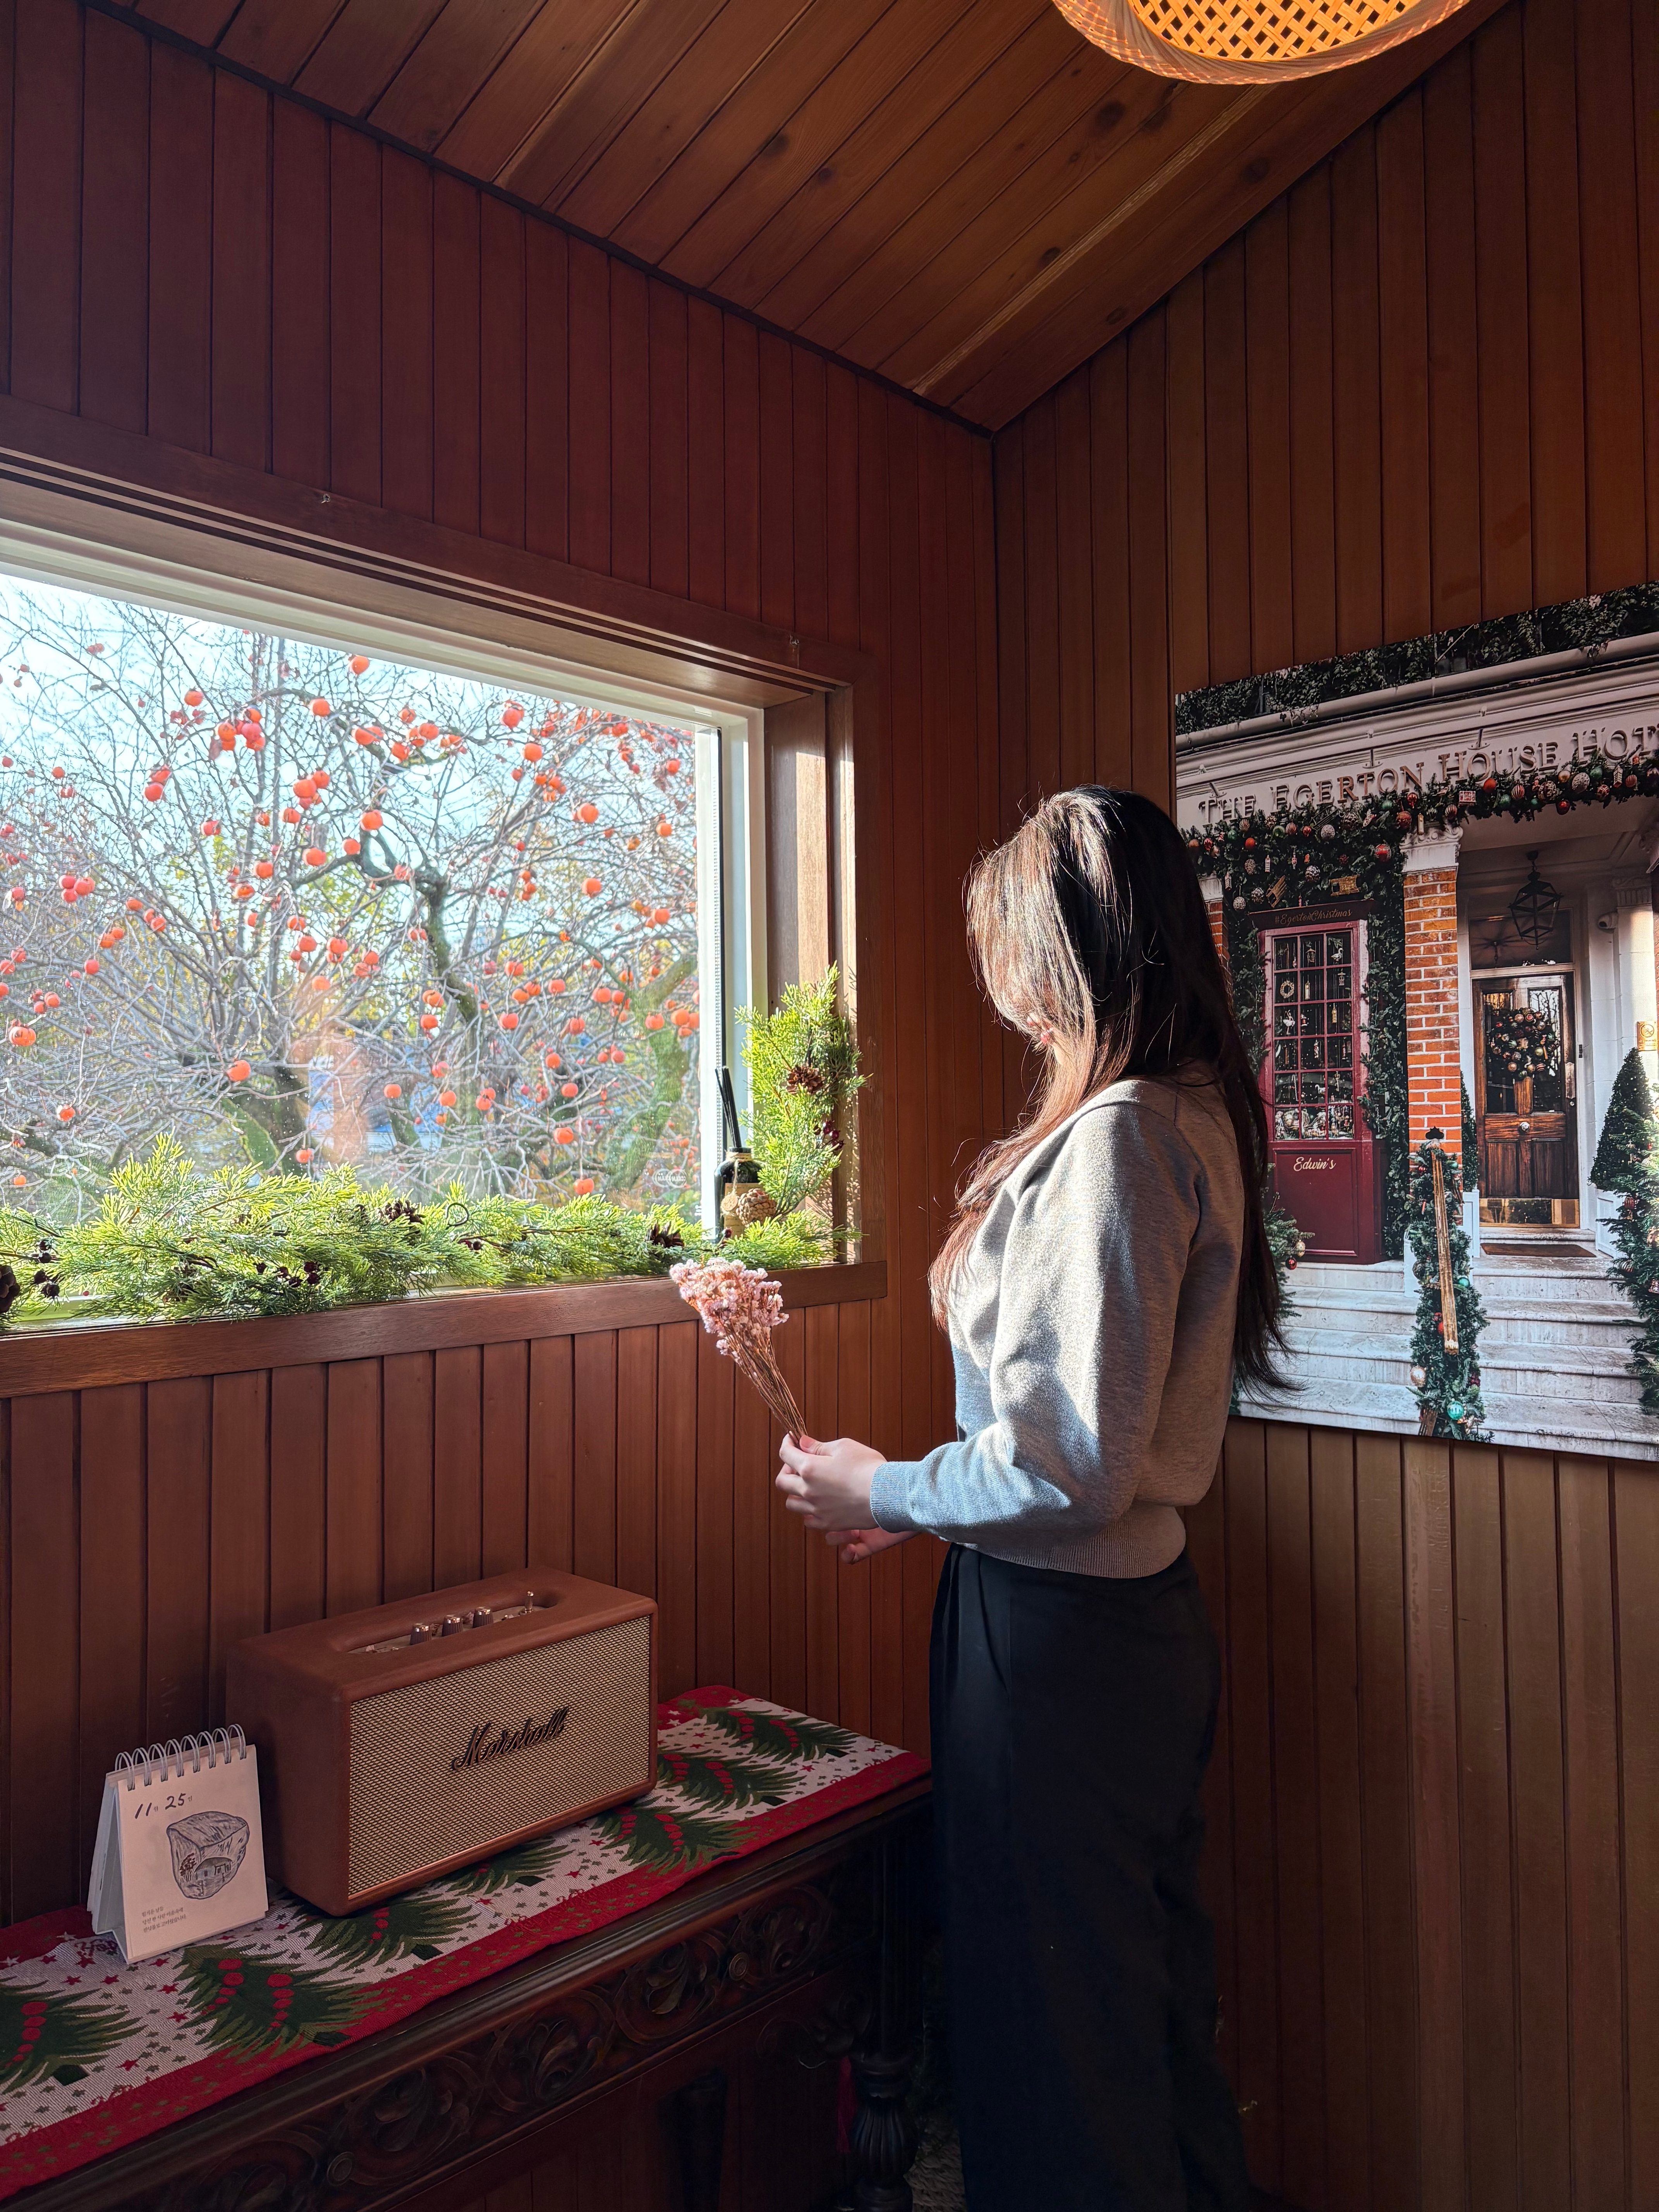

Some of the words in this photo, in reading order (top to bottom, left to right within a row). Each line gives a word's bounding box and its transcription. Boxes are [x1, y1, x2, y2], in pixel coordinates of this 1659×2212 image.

[1198, 794, 1256, 828] THE
[1270, 762, 1425, 813] EGERTON
[1437, 741, 1559, 784] HOUSE
[1275, 909, 1352, 926] #EgertonChristmas
[1293, 1156, 1336, 1171] Edwin's
[451, 1706, 568, 1771] Marshall
